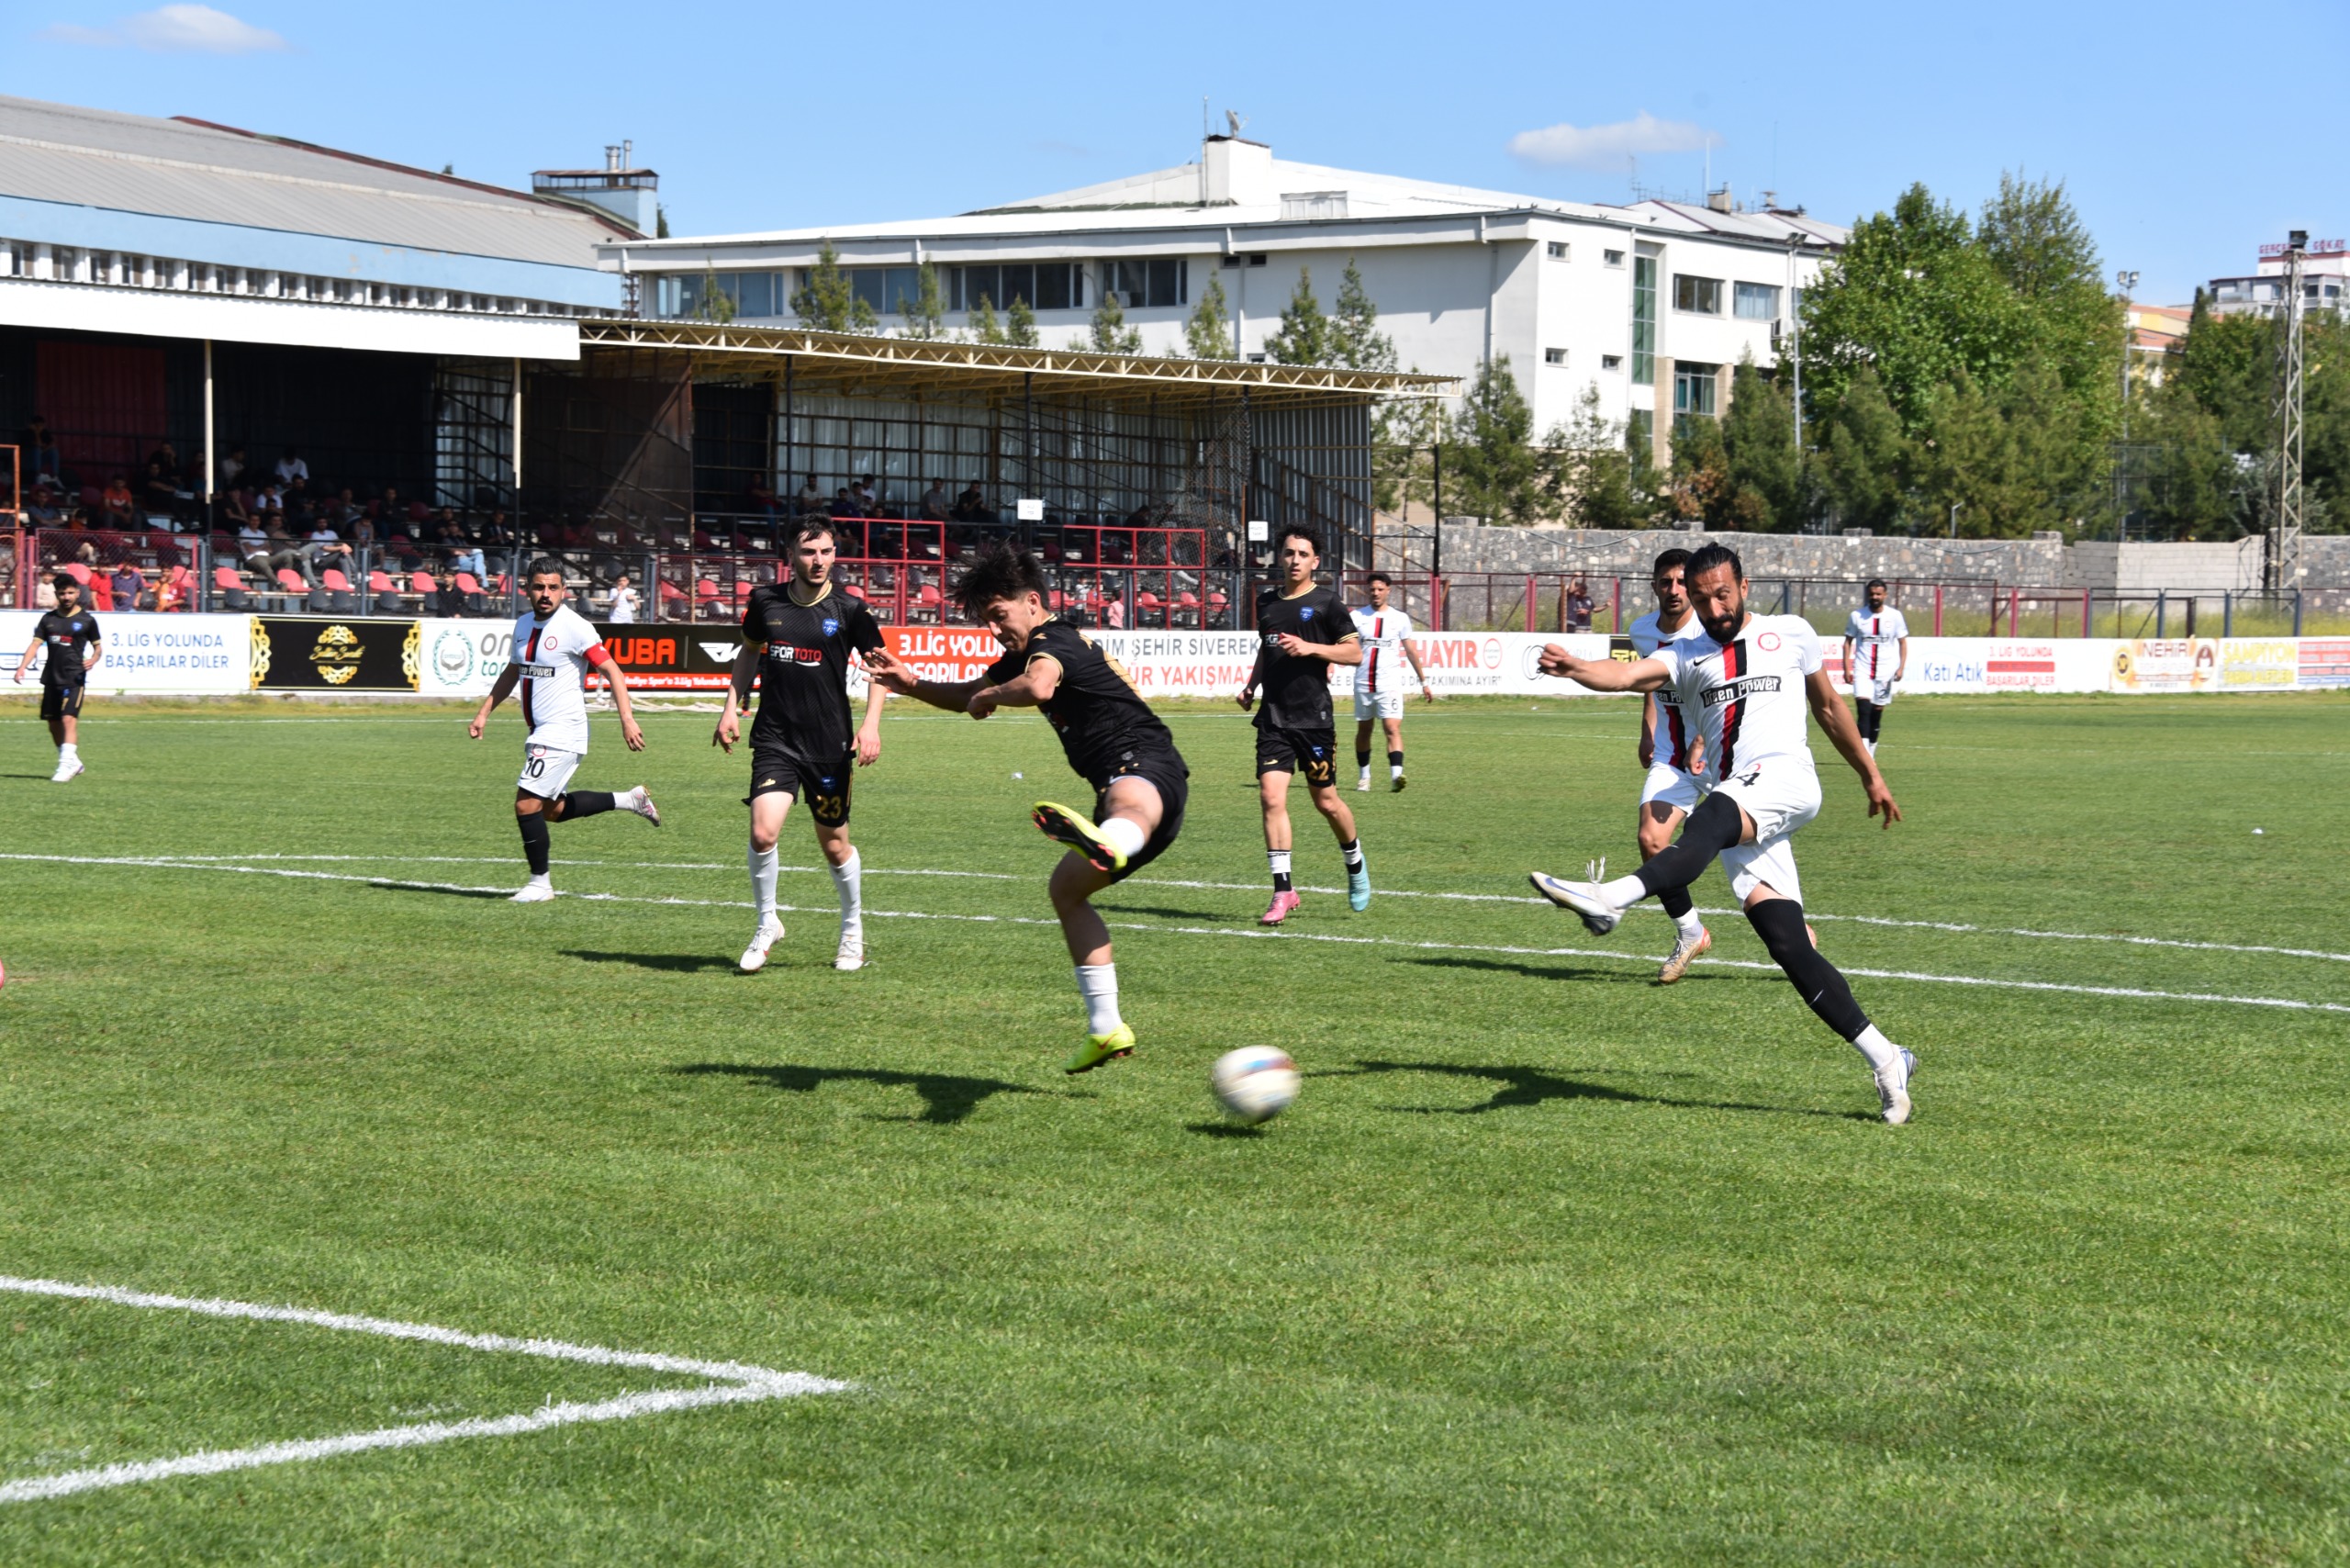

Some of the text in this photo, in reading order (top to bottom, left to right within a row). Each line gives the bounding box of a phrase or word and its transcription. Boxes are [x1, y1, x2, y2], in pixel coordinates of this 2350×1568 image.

[111, 630, 224, 648] 3. LİG YOLUNDA
[1131, 633, 1182, 661] ŞEHİR
[1189, 633, 1260, 655] SİVEREK
[105, 652, 229, 673] BAŞARILAR DİLER
[1924, 662, 1951, 682] Katı
[1954, 661, 1983, 682] Atık
[1737, 676, 1781, 696] Power
[1391, 698, 1399, 711] 6
[526, 756, 545, 778] 10
[815, 795, 843, 818] 23
